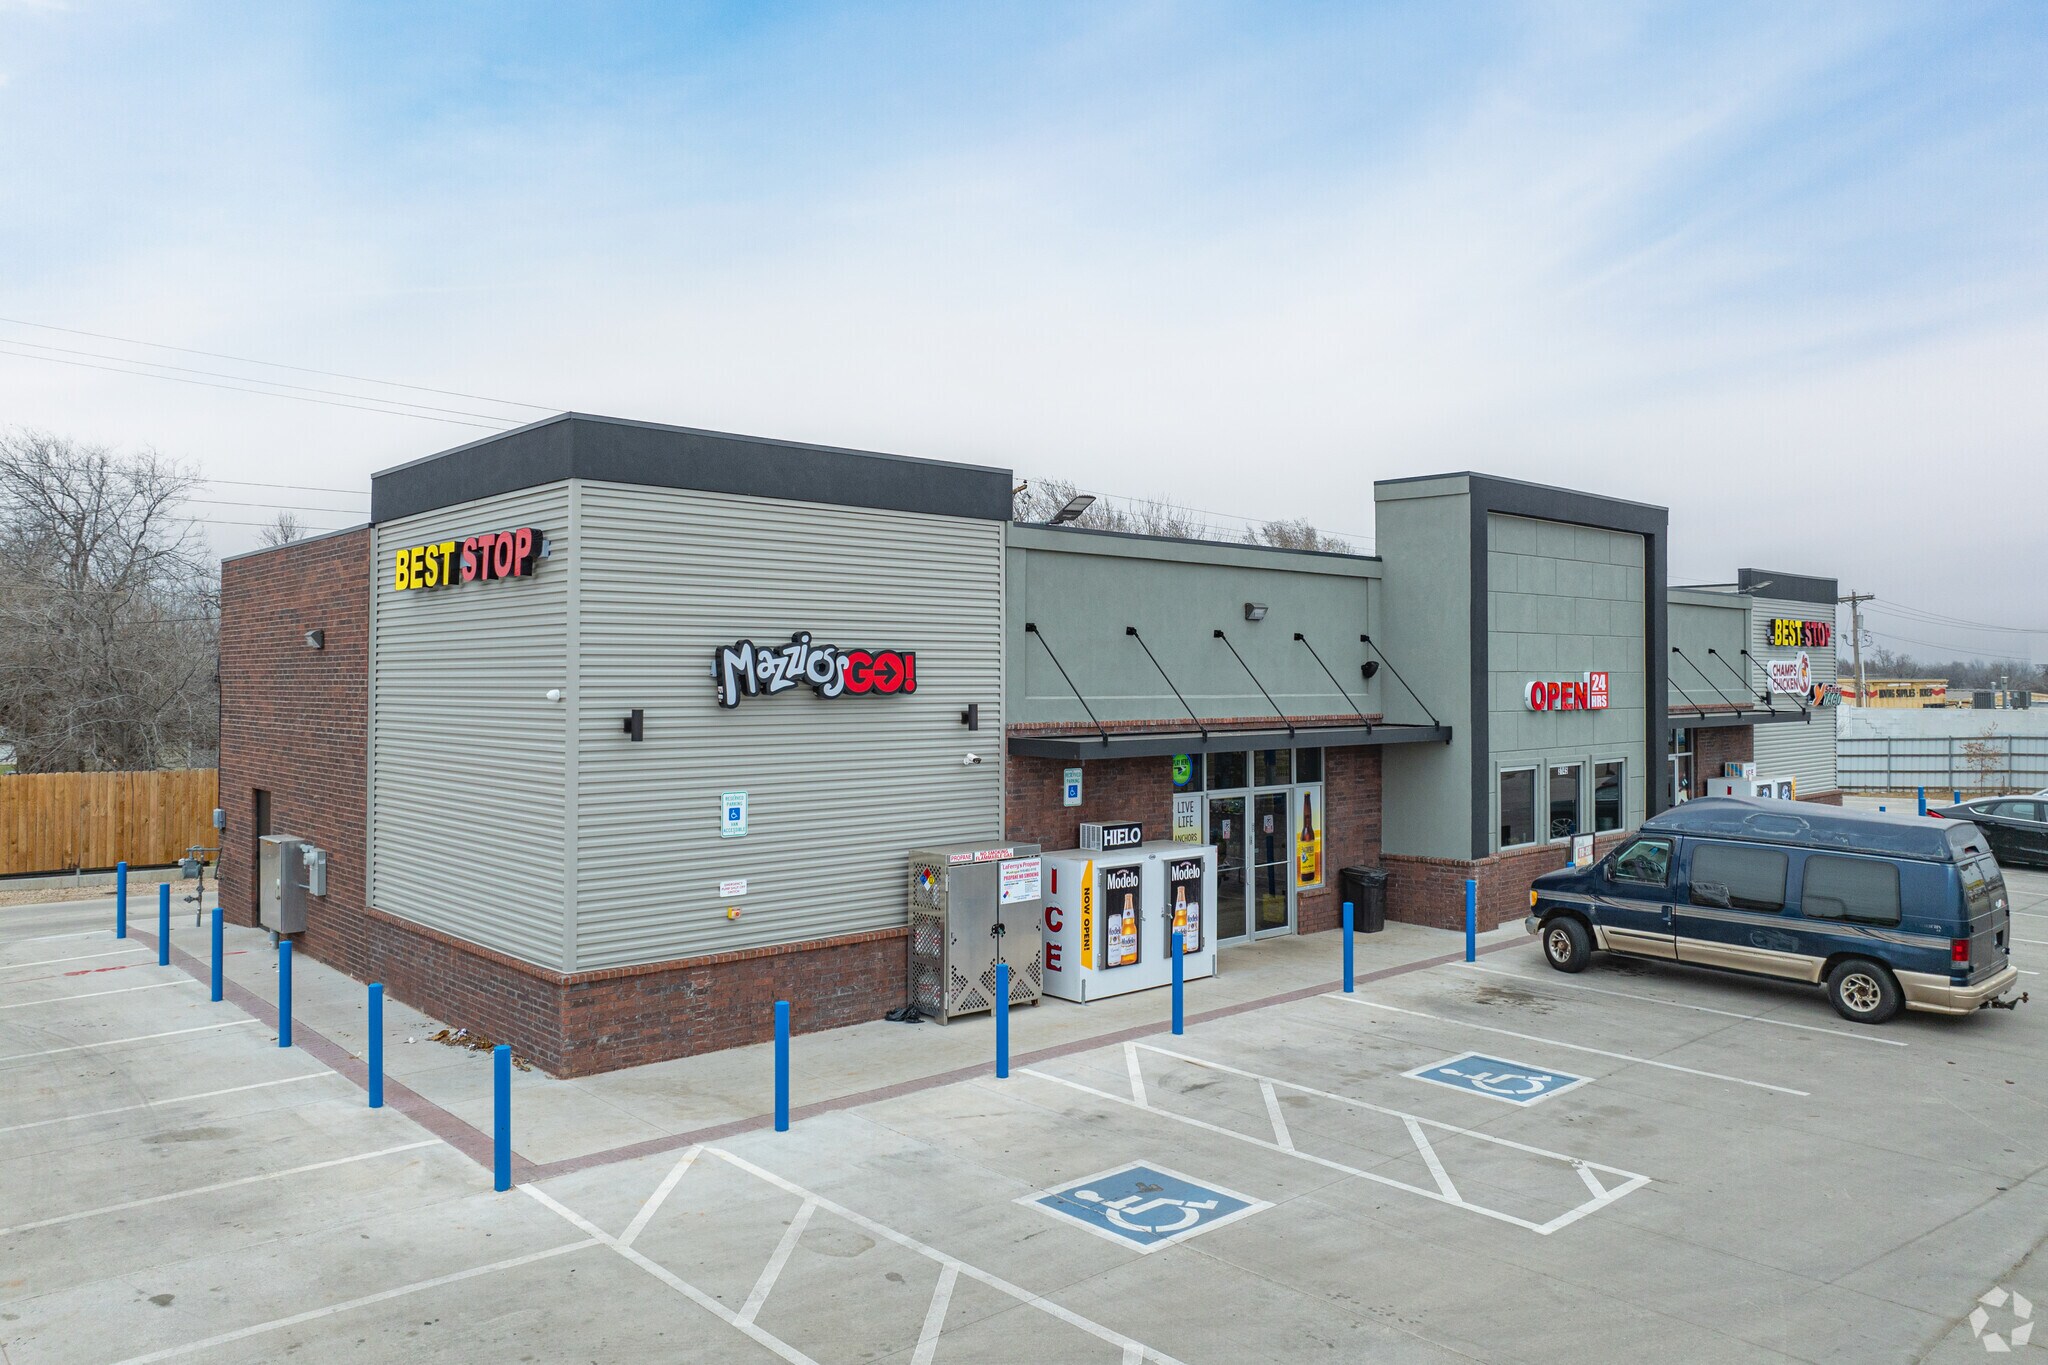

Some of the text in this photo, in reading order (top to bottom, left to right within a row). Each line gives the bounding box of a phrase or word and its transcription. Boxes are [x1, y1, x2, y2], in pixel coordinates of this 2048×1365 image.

[395, 527, 533, 591] BEST STOP
[1775, 618, 1831, 647] BEST STOP
[1772, 664, 1797, 676] CHAMPS
[1772, 678, 1799, 691] CHICKEN
[1530, 674, 1606, 711] OPEN 24
[1823, 692, 1842, 705] TACO
[1591, 694, 1607, 708] HRS
[1177, 801, 1194, 814] LIVE
[1178, 815, 1194, 828] LIFE
[1103, 827, 1142, 847] HIELO
[1174, 833, 1198, 842] ANCHORS
[950, 853, 972, 861] PROPANE
[975, 853, 1002, 861] FLAMMABLE
[1171, 864, 1200, 882] Modelo
[1107, 871, 1139, 890] Modelo
[1045, 864, 1064, 973] ICE
